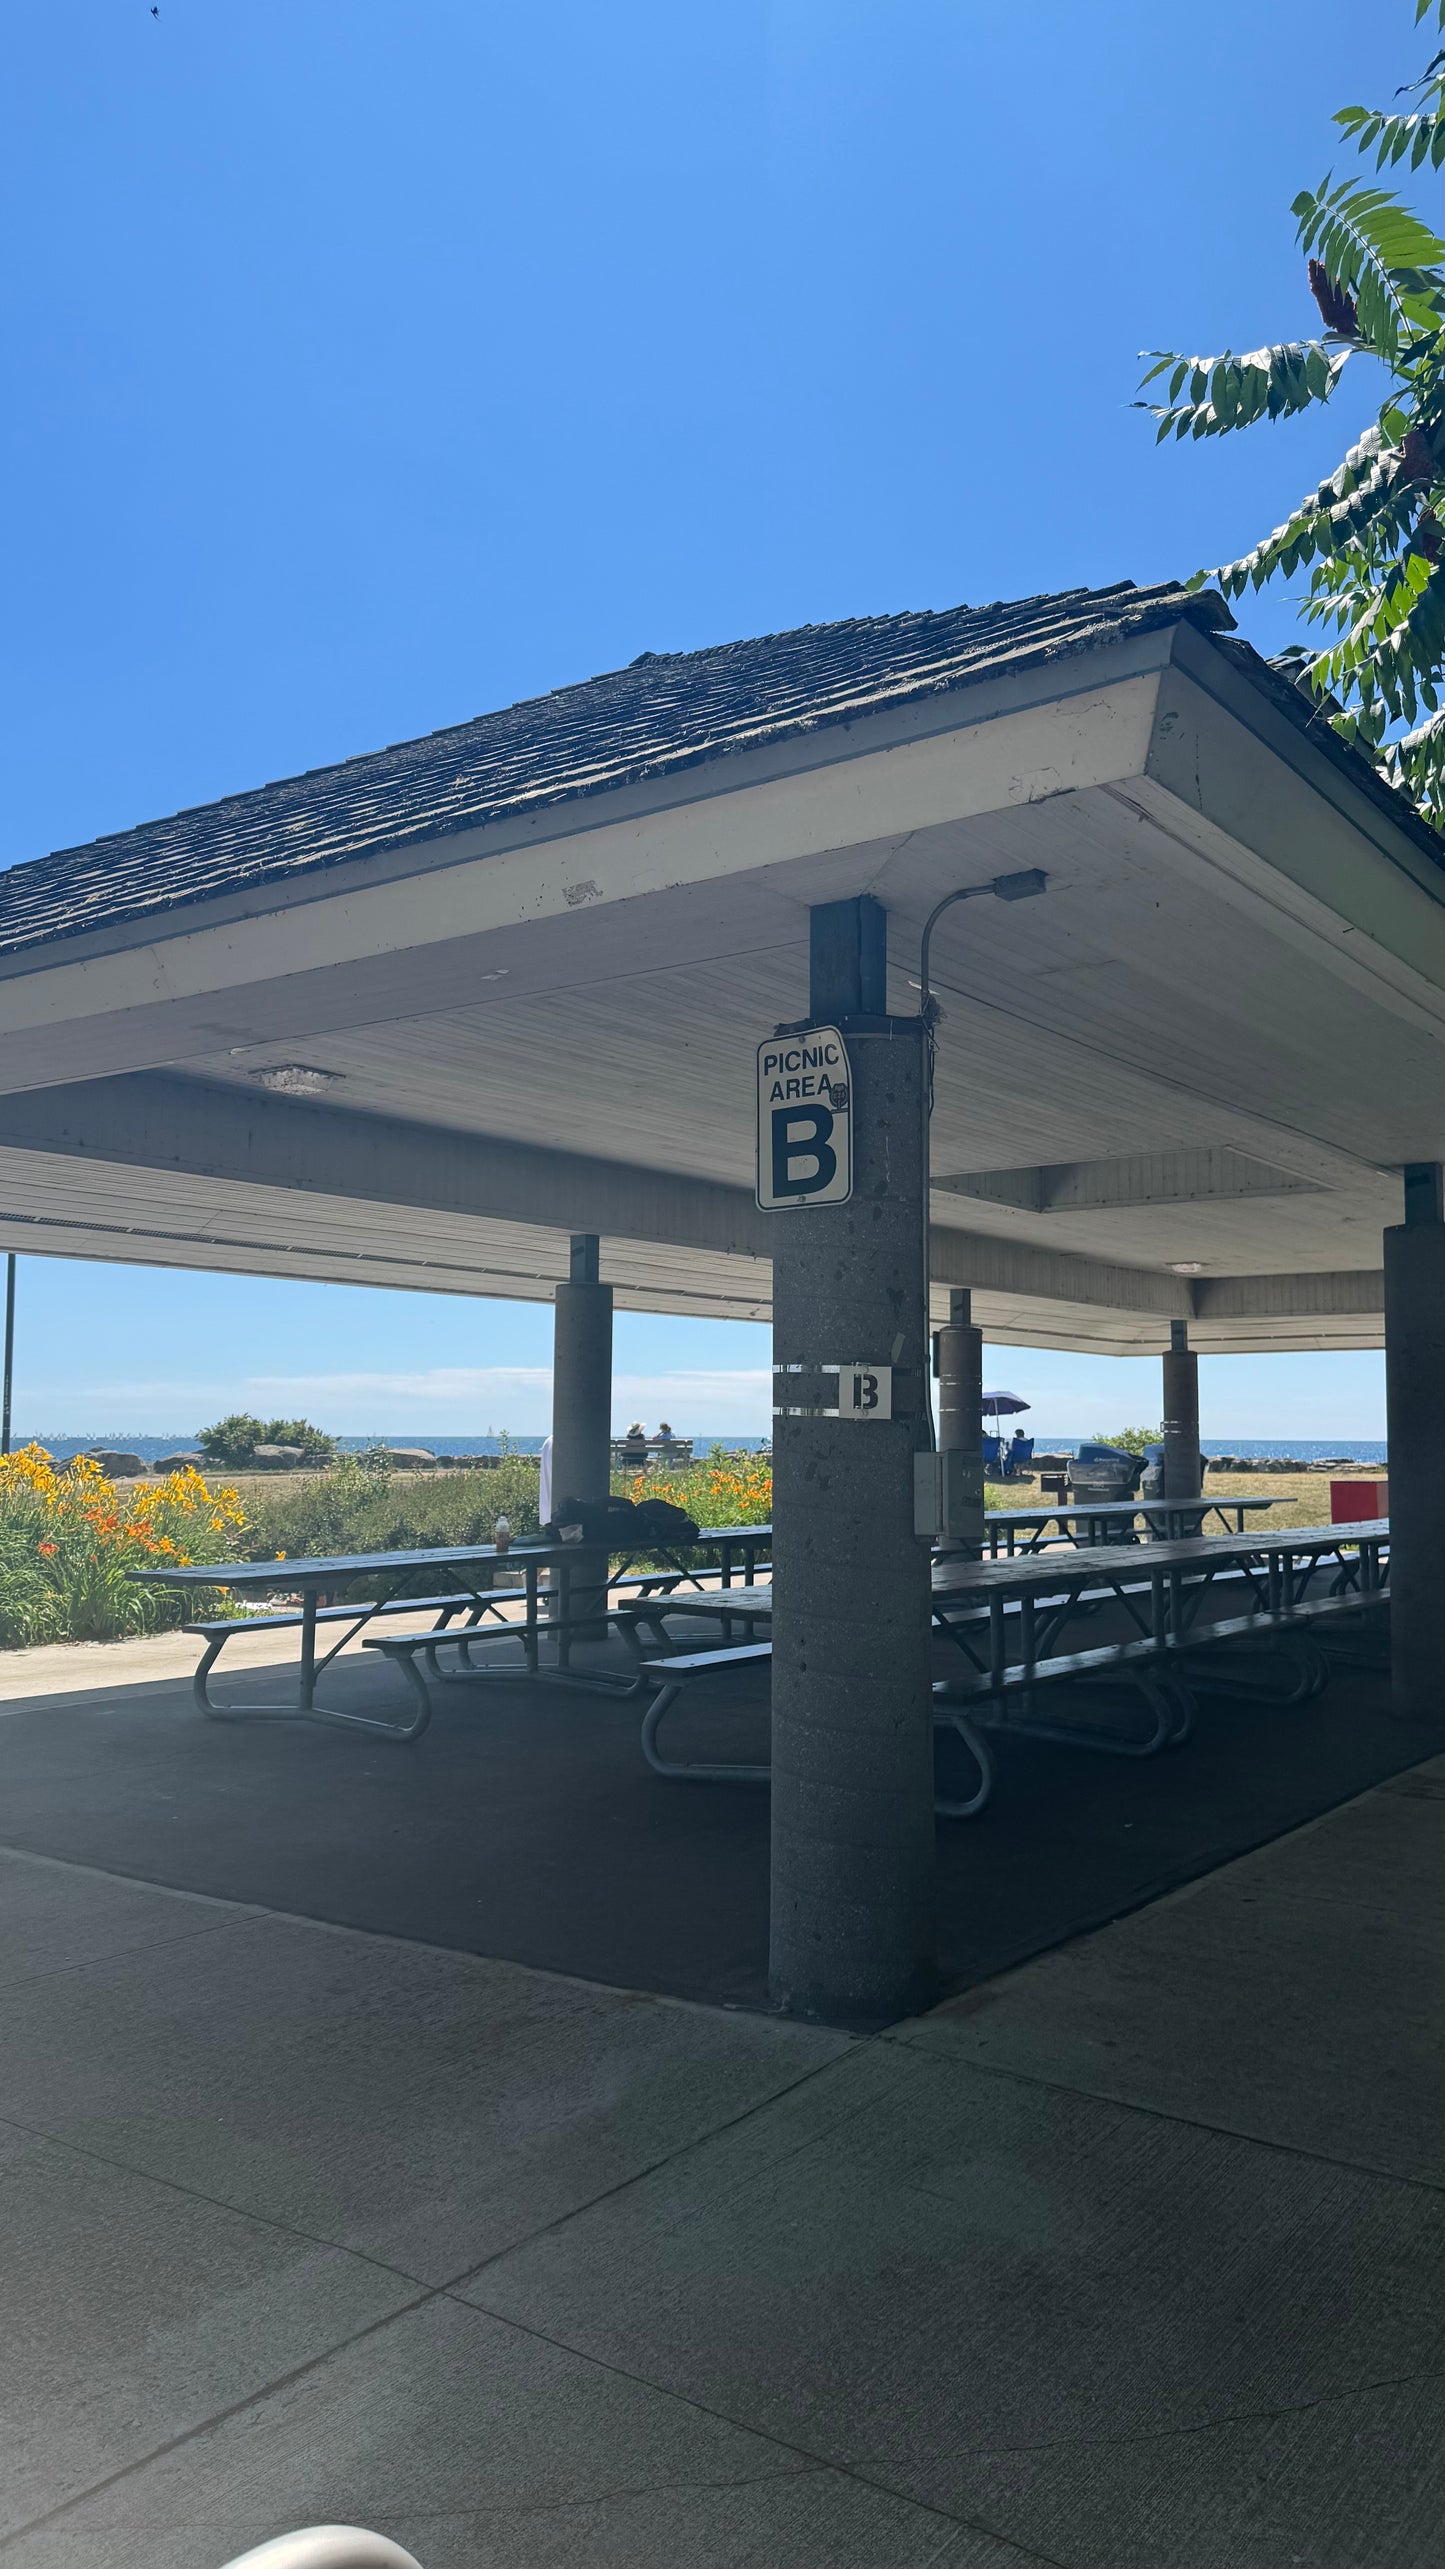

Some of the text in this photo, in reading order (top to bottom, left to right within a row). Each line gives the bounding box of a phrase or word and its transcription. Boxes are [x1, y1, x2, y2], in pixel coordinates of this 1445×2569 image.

[764, 1044, 839, 1076] PICNIC
[770, 1074, 832, 1102] AREA
[772, 1104, 836, 1198] B
[853, 1374, 878, 1409] B
